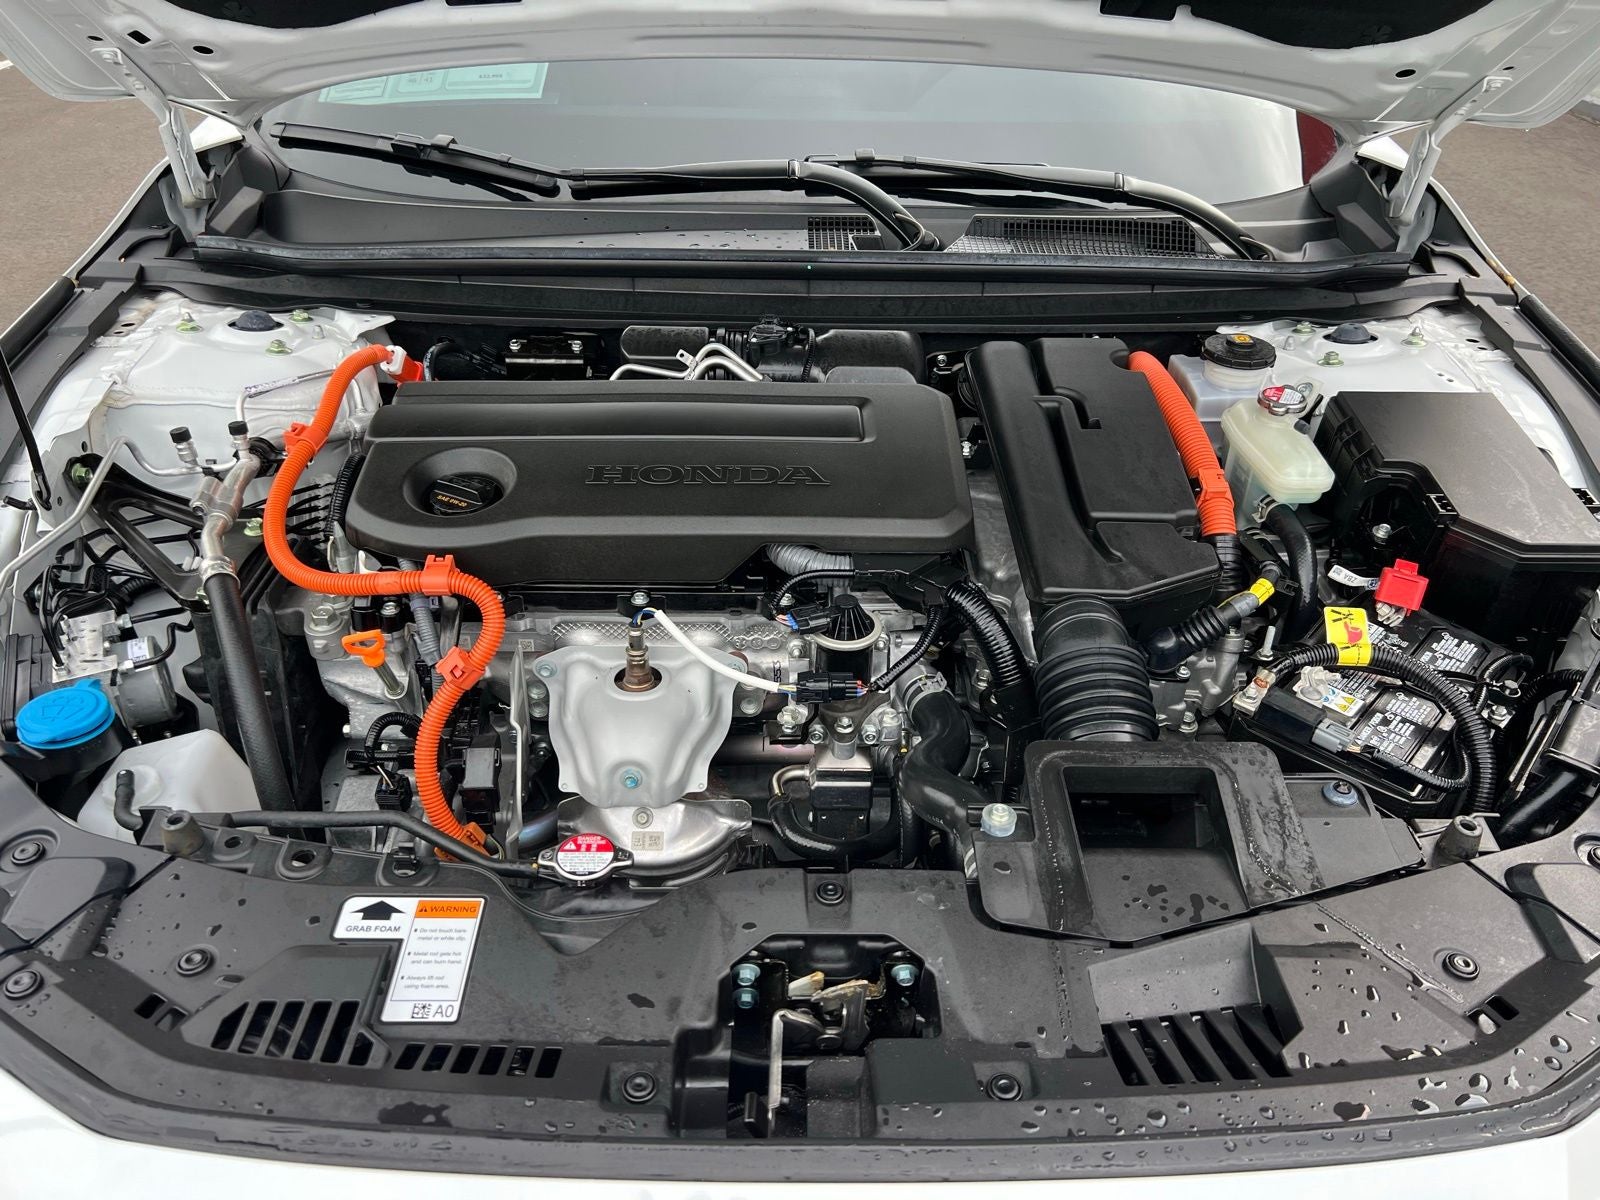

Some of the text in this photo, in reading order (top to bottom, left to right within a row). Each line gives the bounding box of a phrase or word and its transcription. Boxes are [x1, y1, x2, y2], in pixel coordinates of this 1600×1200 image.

[584, 464, 832, 486] HONDA
[436, 494, 468, 508] SAE 0W-20
[429, 905, 478, 913] WARNING
[432, 1004, 454, 1018] A0
